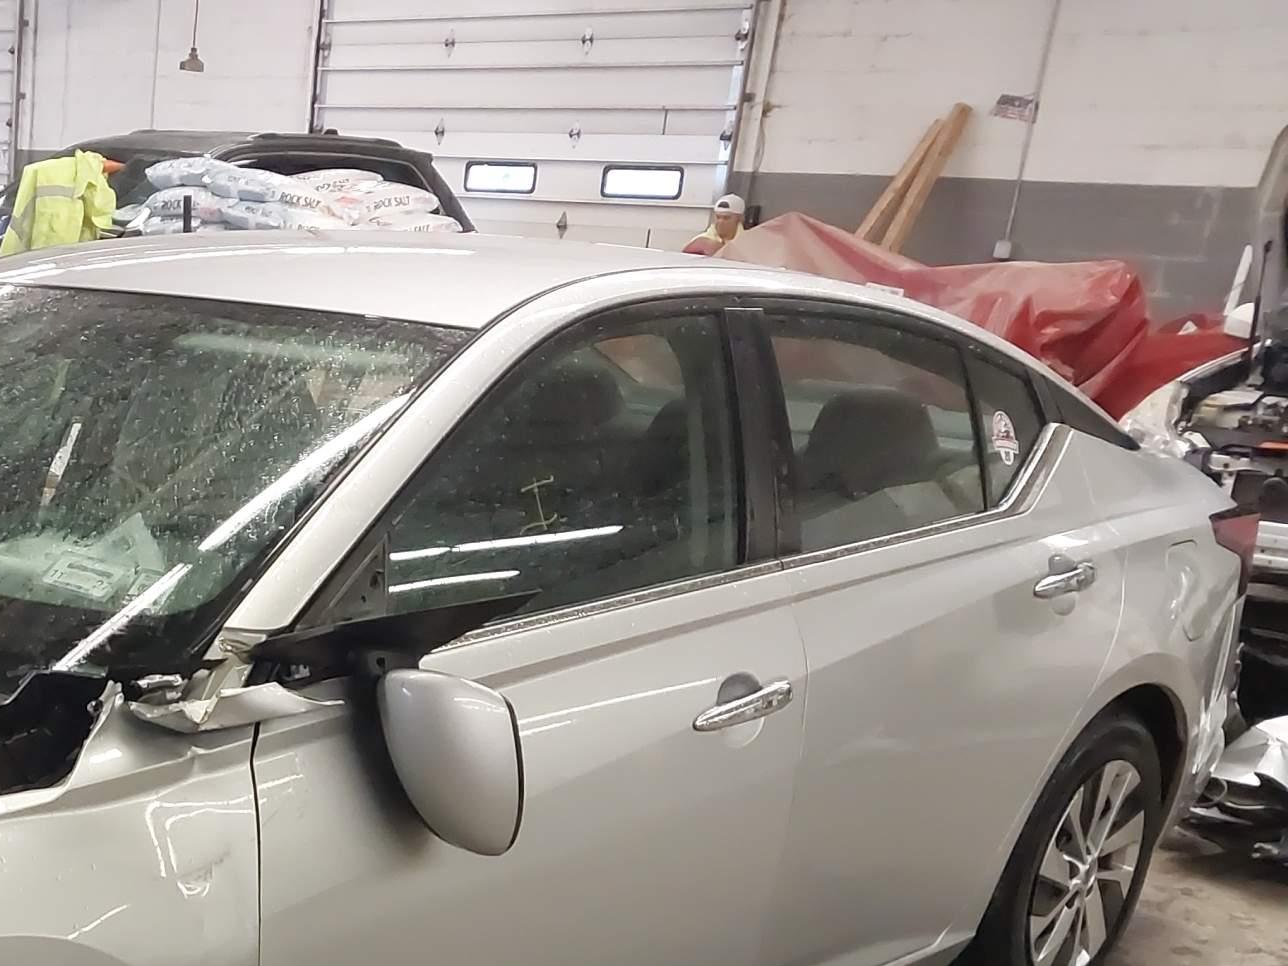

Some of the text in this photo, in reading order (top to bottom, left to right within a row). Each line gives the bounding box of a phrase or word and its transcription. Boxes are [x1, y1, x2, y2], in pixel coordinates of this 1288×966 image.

[279, 191, 322, 209] ROCK SALT
[373, 195, 410, 211] ROCK SALT
